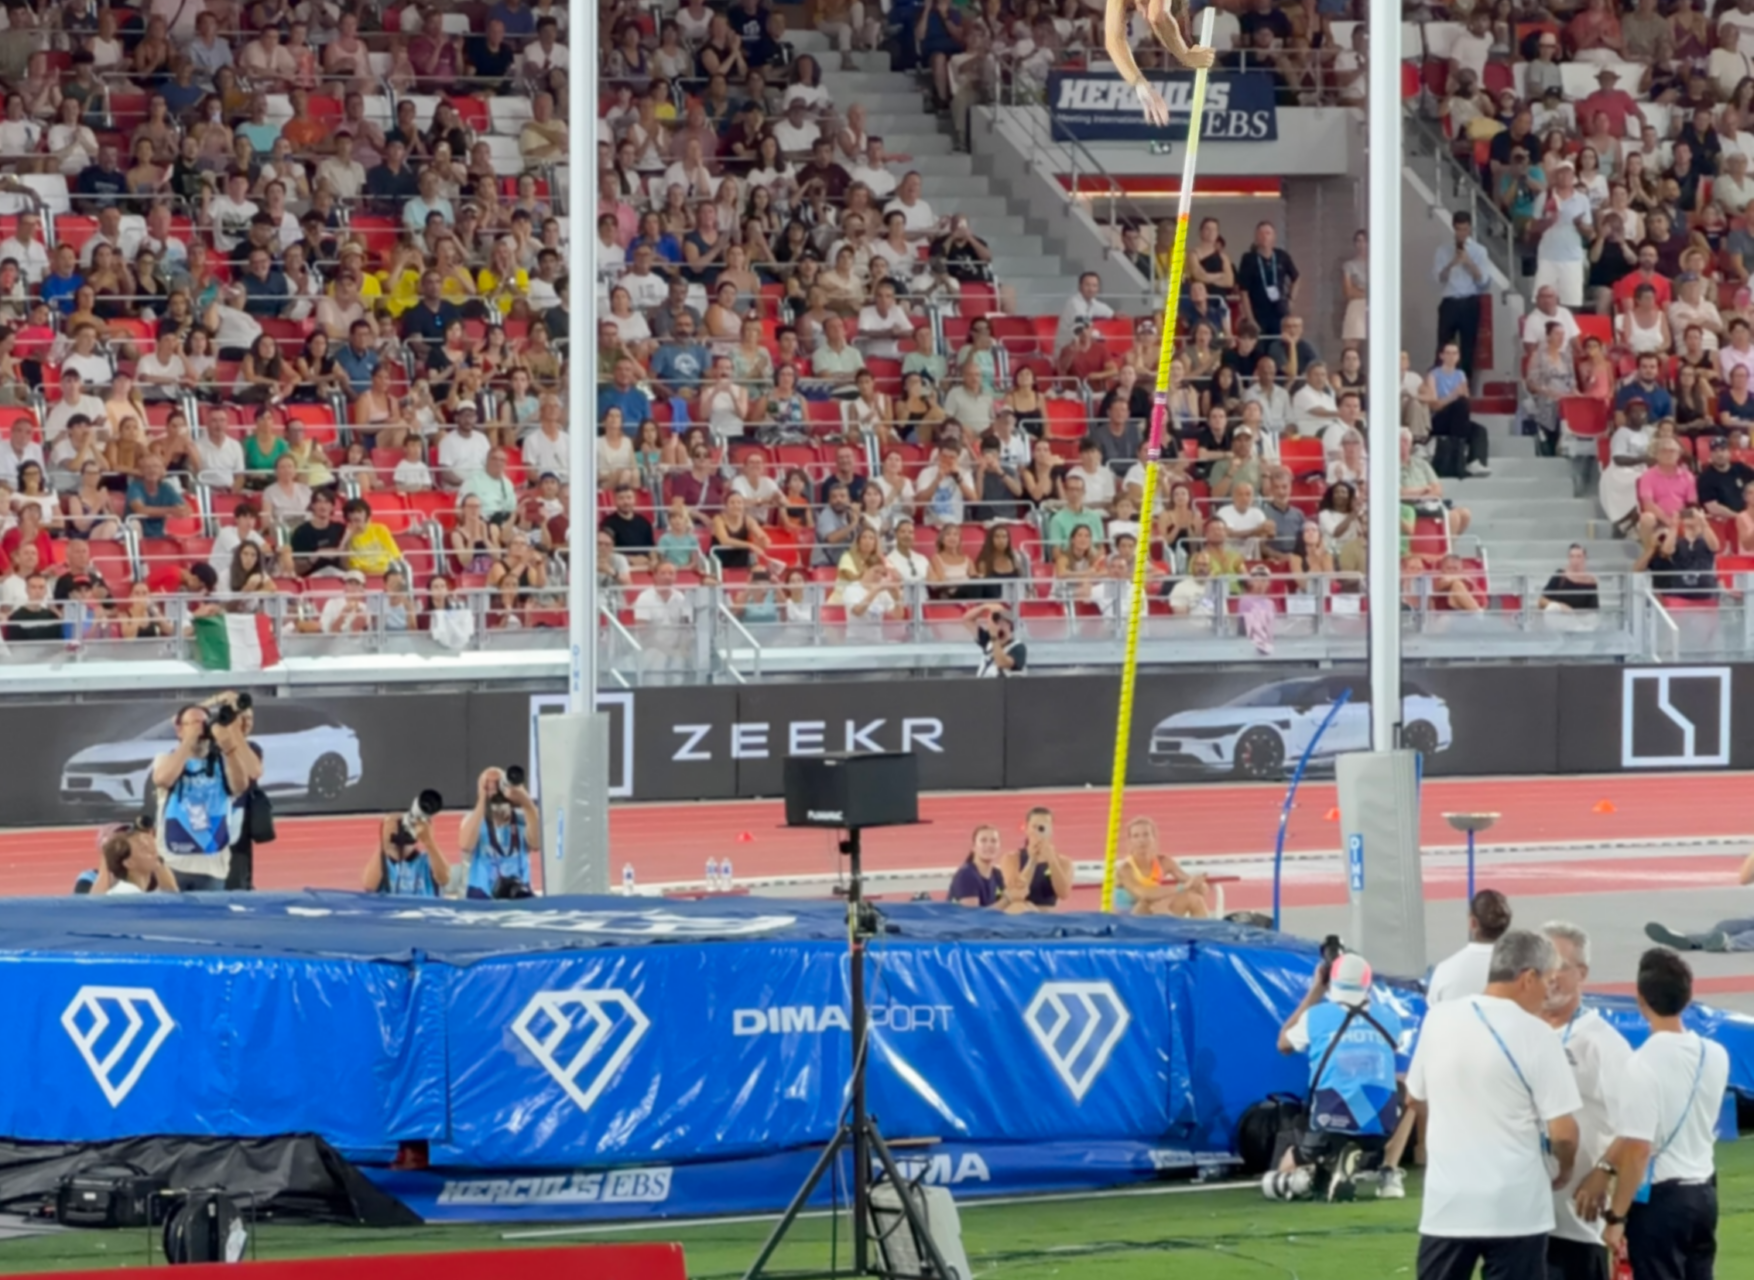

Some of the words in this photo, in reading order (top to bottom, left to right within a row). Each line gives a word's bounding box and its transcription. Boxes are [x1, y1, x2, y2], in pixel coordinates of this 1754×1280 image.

[1056, 79, 1231, 111] HERULS
[1202, 110, 1269, 138] EBS
[672, 717, 944, 760] ZEEKR
[1350, 836, 1361, 888] DIMA
[733, 1005, 850, 1036] DIMA
[862, 1004, 954, 1032] PORT
[612, 1172, 667, 1198] EBS
